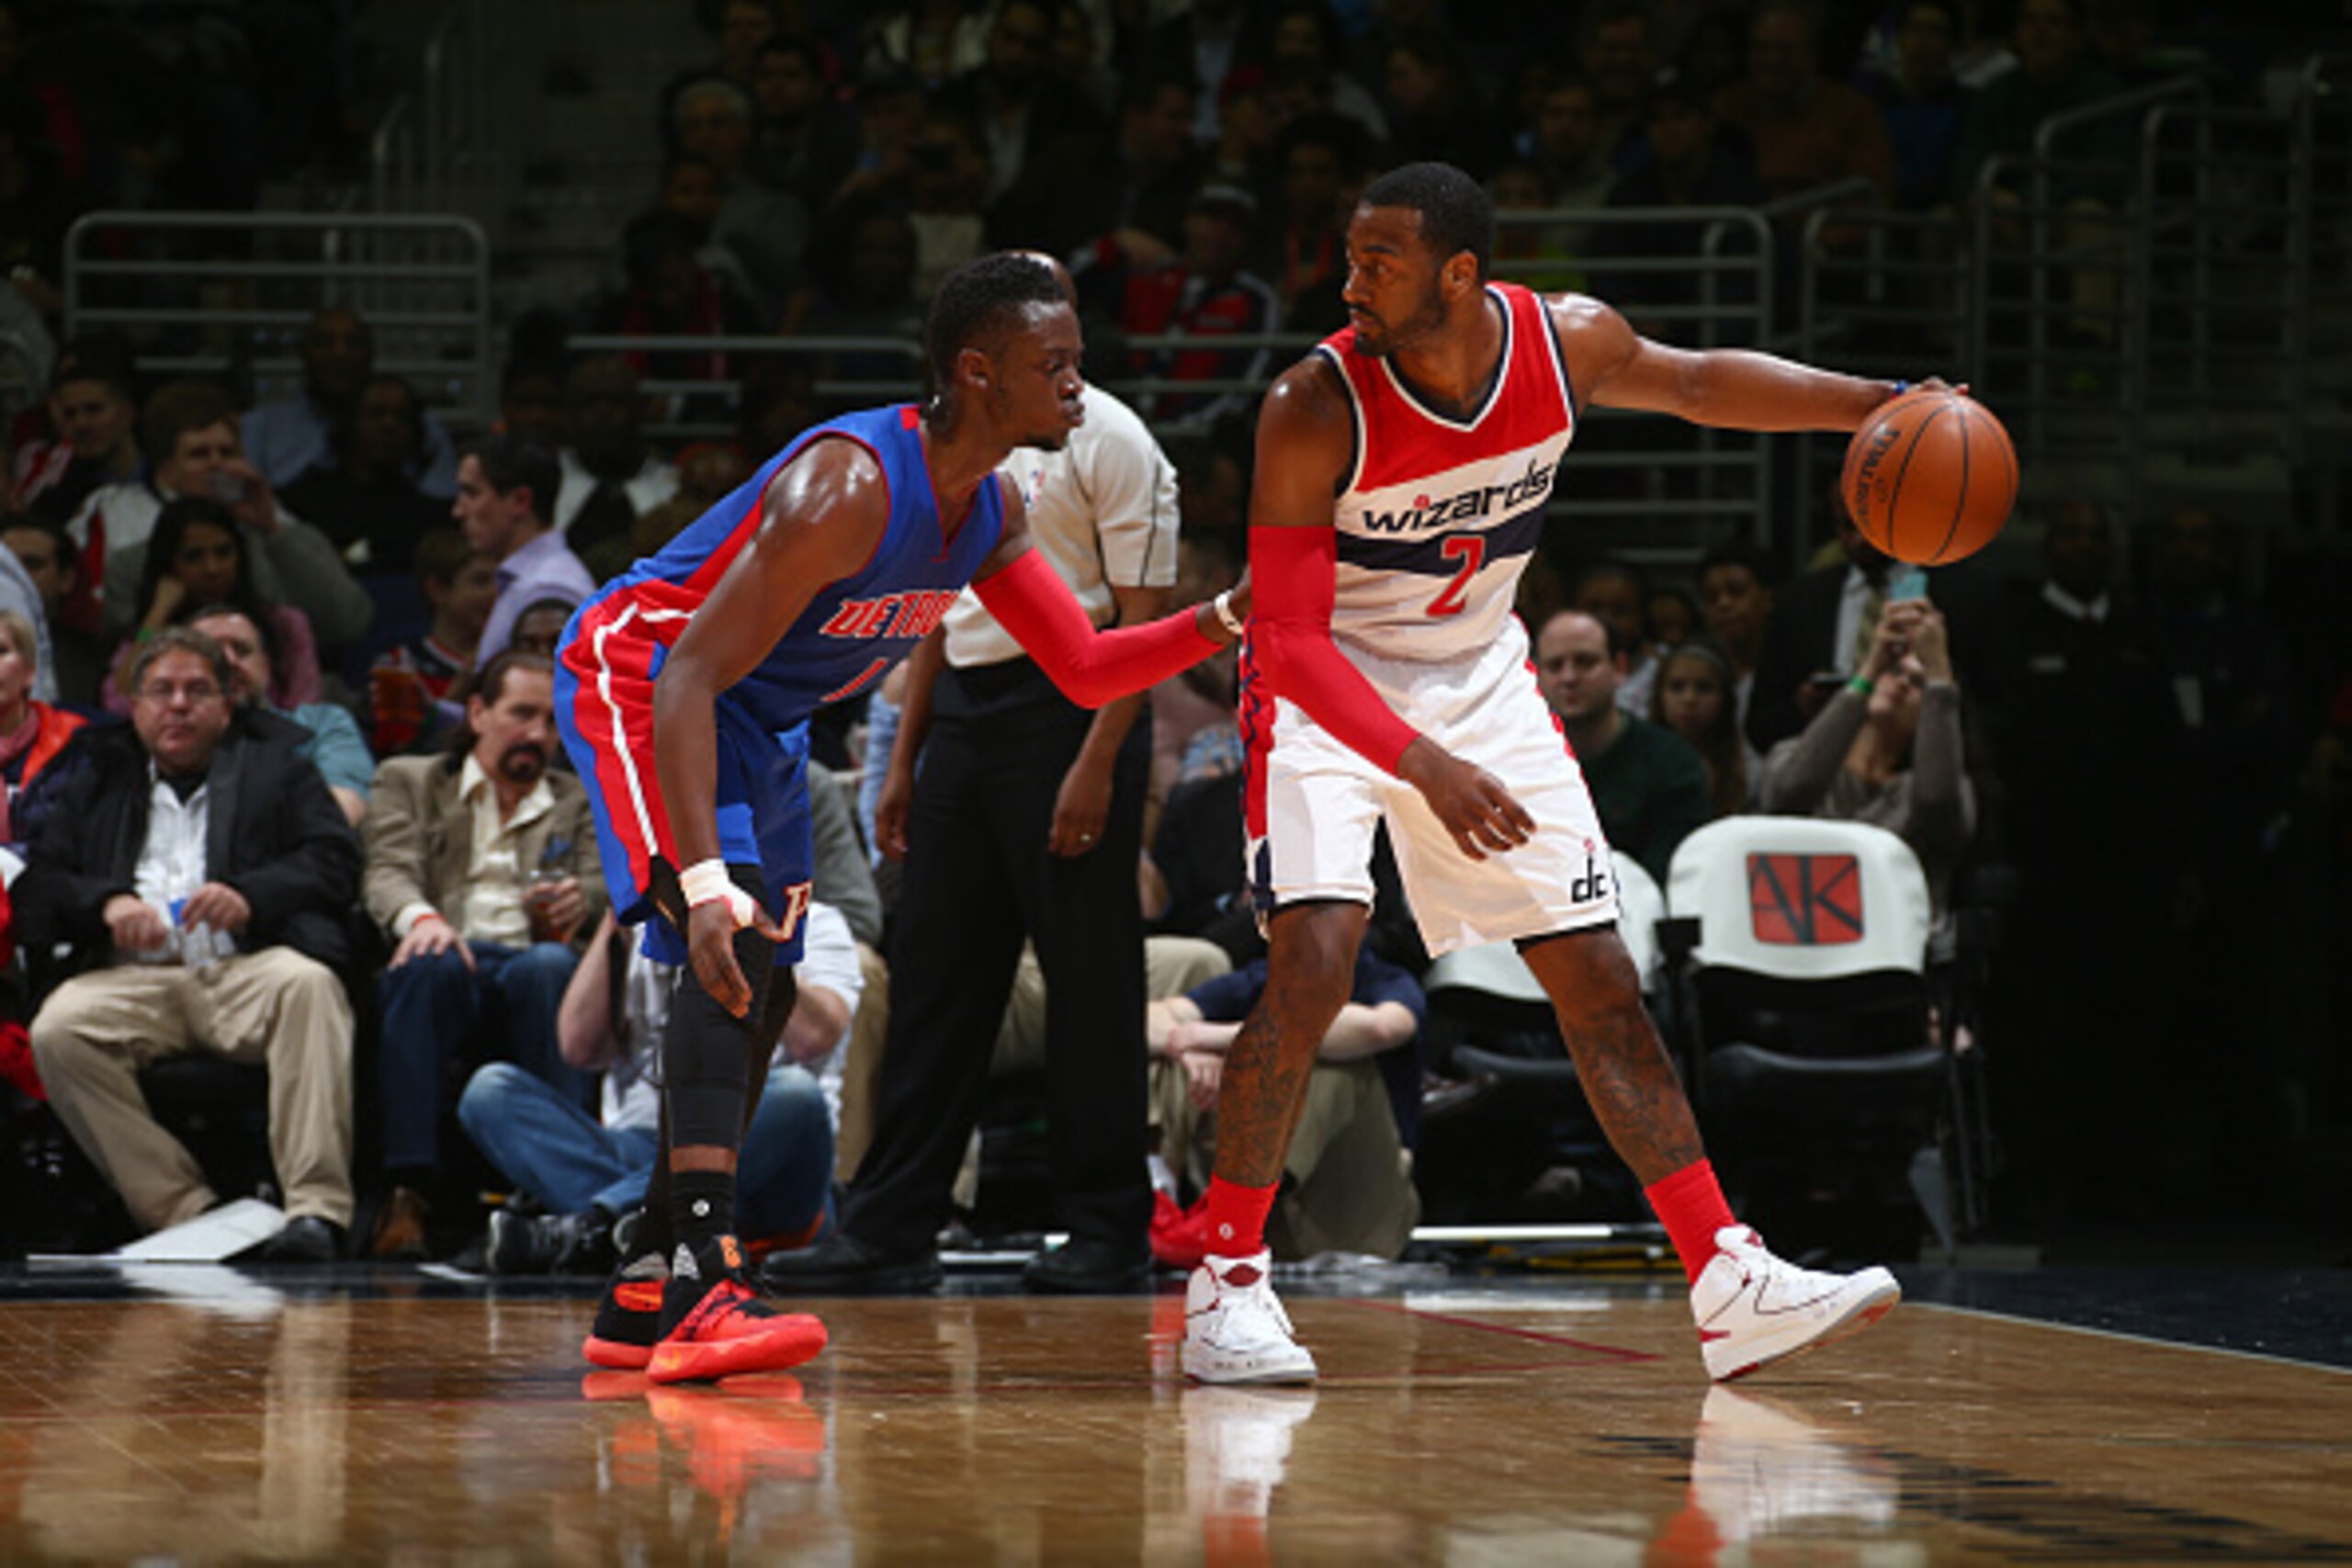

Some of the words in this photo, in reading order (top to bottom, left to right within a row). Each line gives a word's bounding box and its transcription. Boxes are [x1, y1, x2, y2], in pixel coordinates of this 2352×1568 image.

[1362, 459, 1554, 532] wizards
[1425, 536, 1486, 617] 2
[822, 658, 888, 701] 1
[1571, 843, 1608, 903] dc
